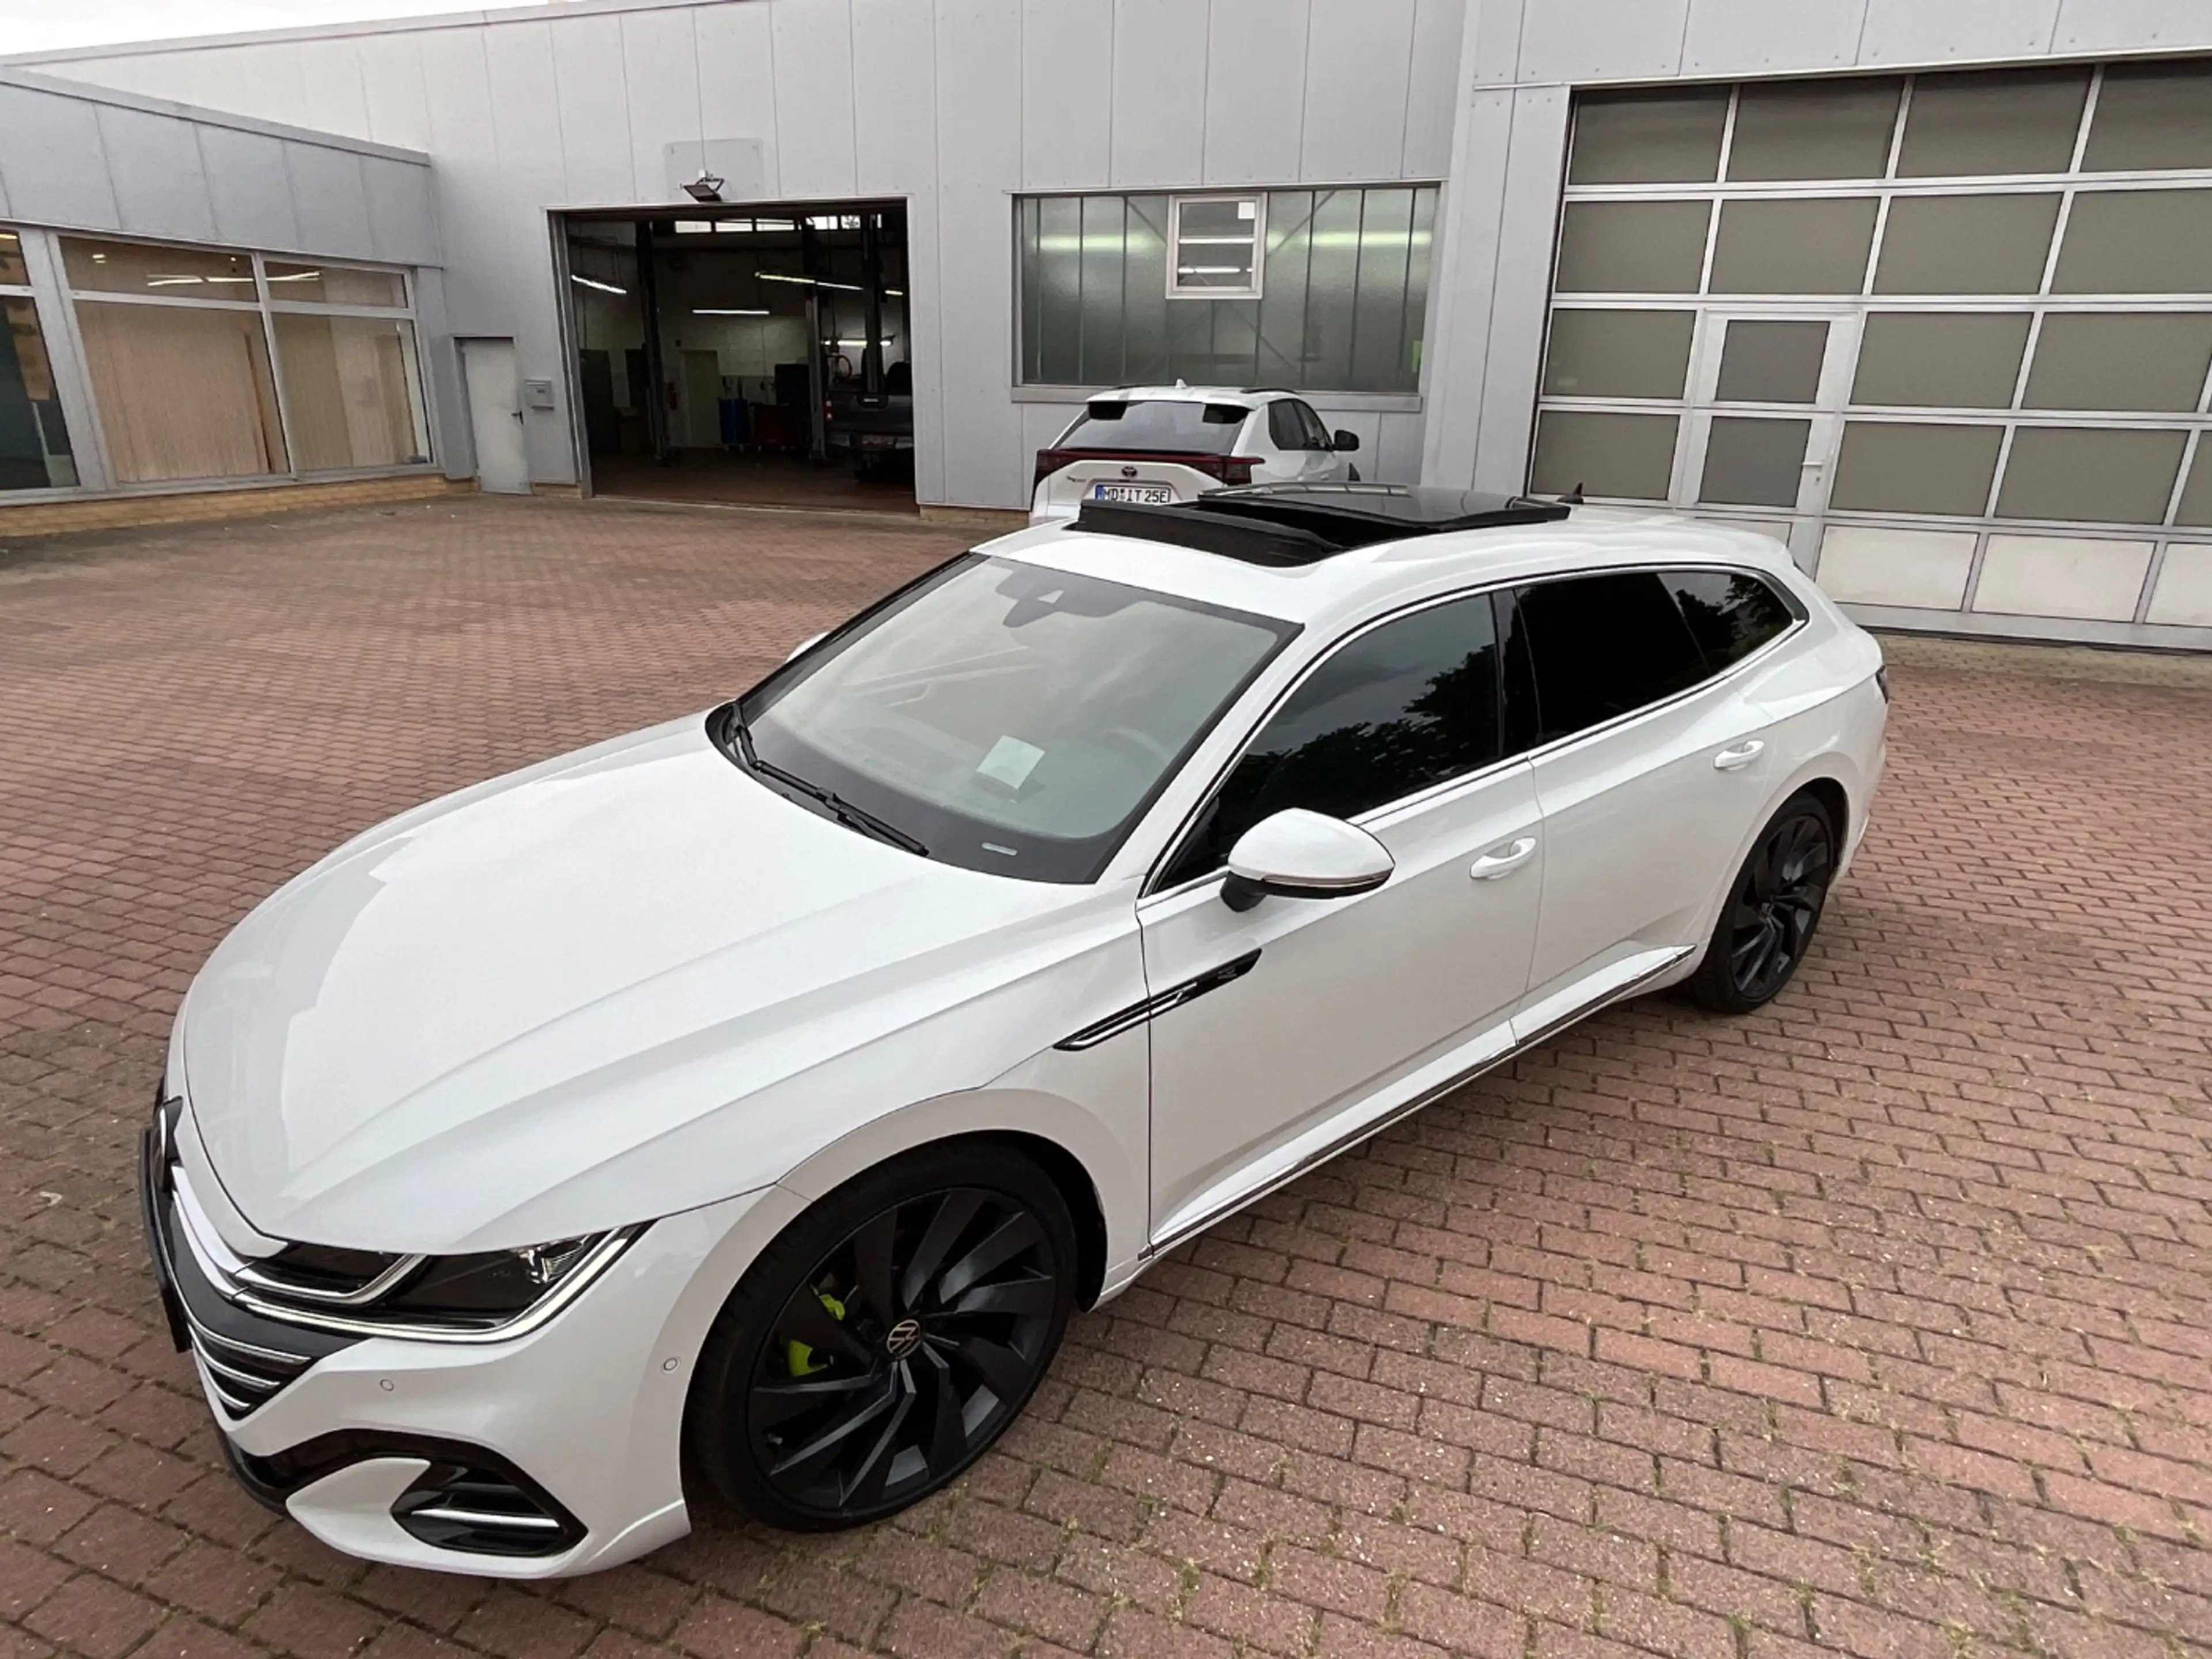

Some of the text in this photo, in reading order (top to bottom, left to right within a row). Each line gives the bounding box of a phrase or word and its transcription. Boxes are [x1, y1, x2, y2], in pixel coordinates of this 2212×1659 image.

[1103, 488, 1166, 503] MD IT 25E
